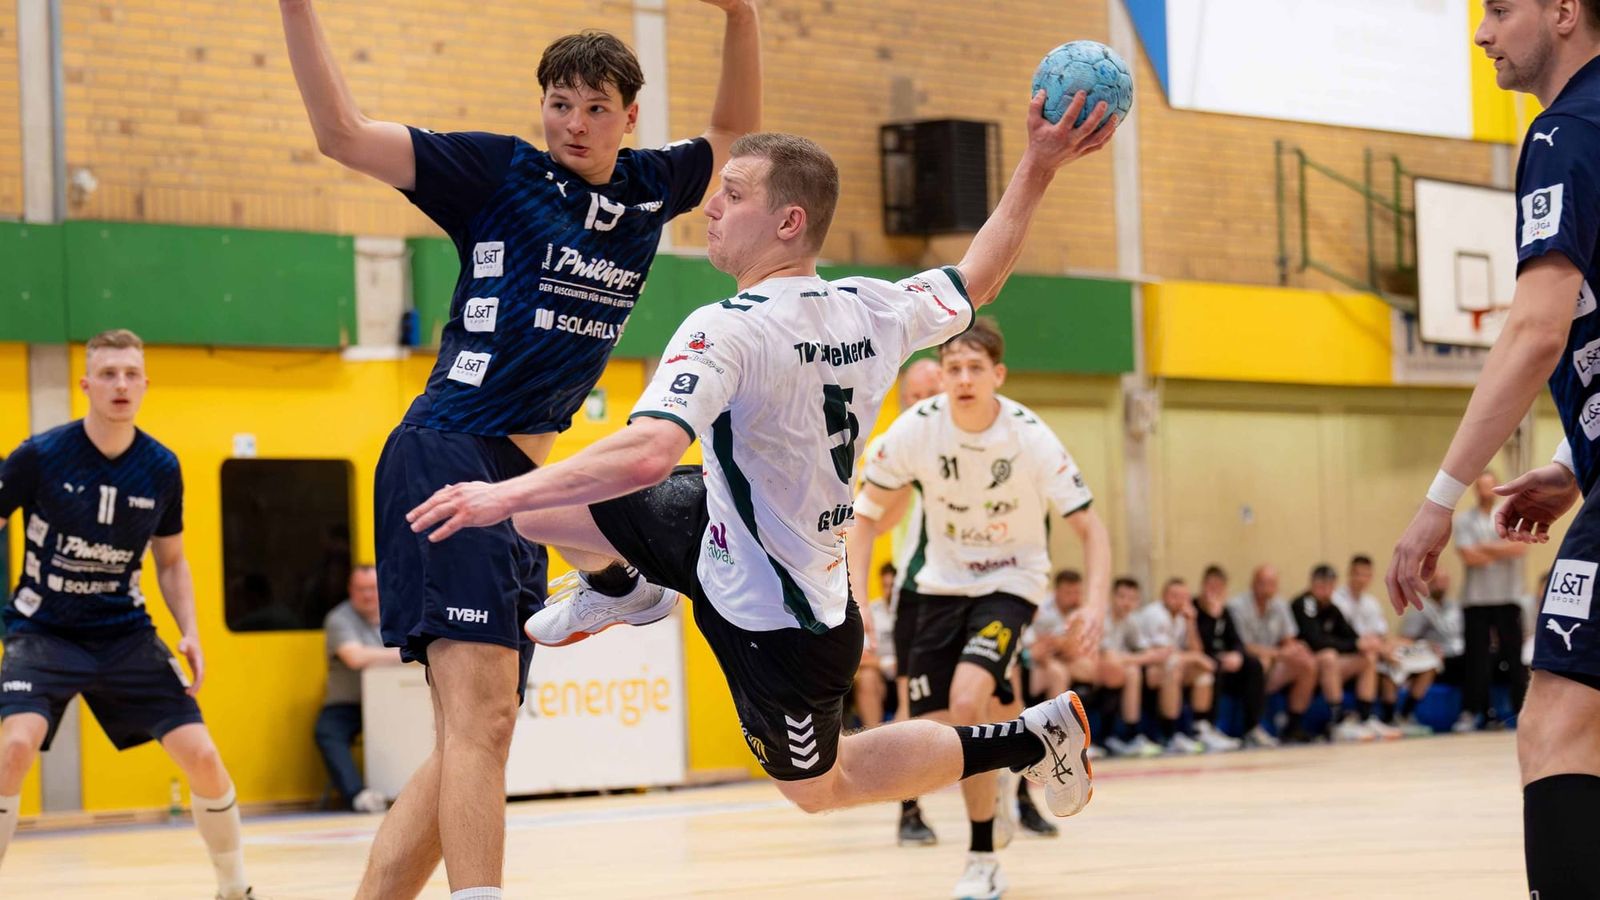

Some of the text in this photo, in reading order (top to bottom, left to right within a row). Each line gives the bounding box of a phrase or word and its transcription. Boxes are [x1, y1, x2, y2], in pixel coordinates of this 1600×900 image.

[475, 249, 501, 265] L&T
[539, 283, 553, 293] DER
[554, 286, 588, 299] DISCOUNTER
[588, 292, 599, 302] FÜR
[467, 305, 494, 319] L&T
[456, 356, 485, 373] L&T
[823, 384, 859, 485] 5
[98, 485, 118, 525] 11
[1551, 572, 1590, 597] L&T
[1552, 596, 1581, 605] SPORT
[446, 606, 489, 624] TVBH
[909, 675, 930, 701] 31
